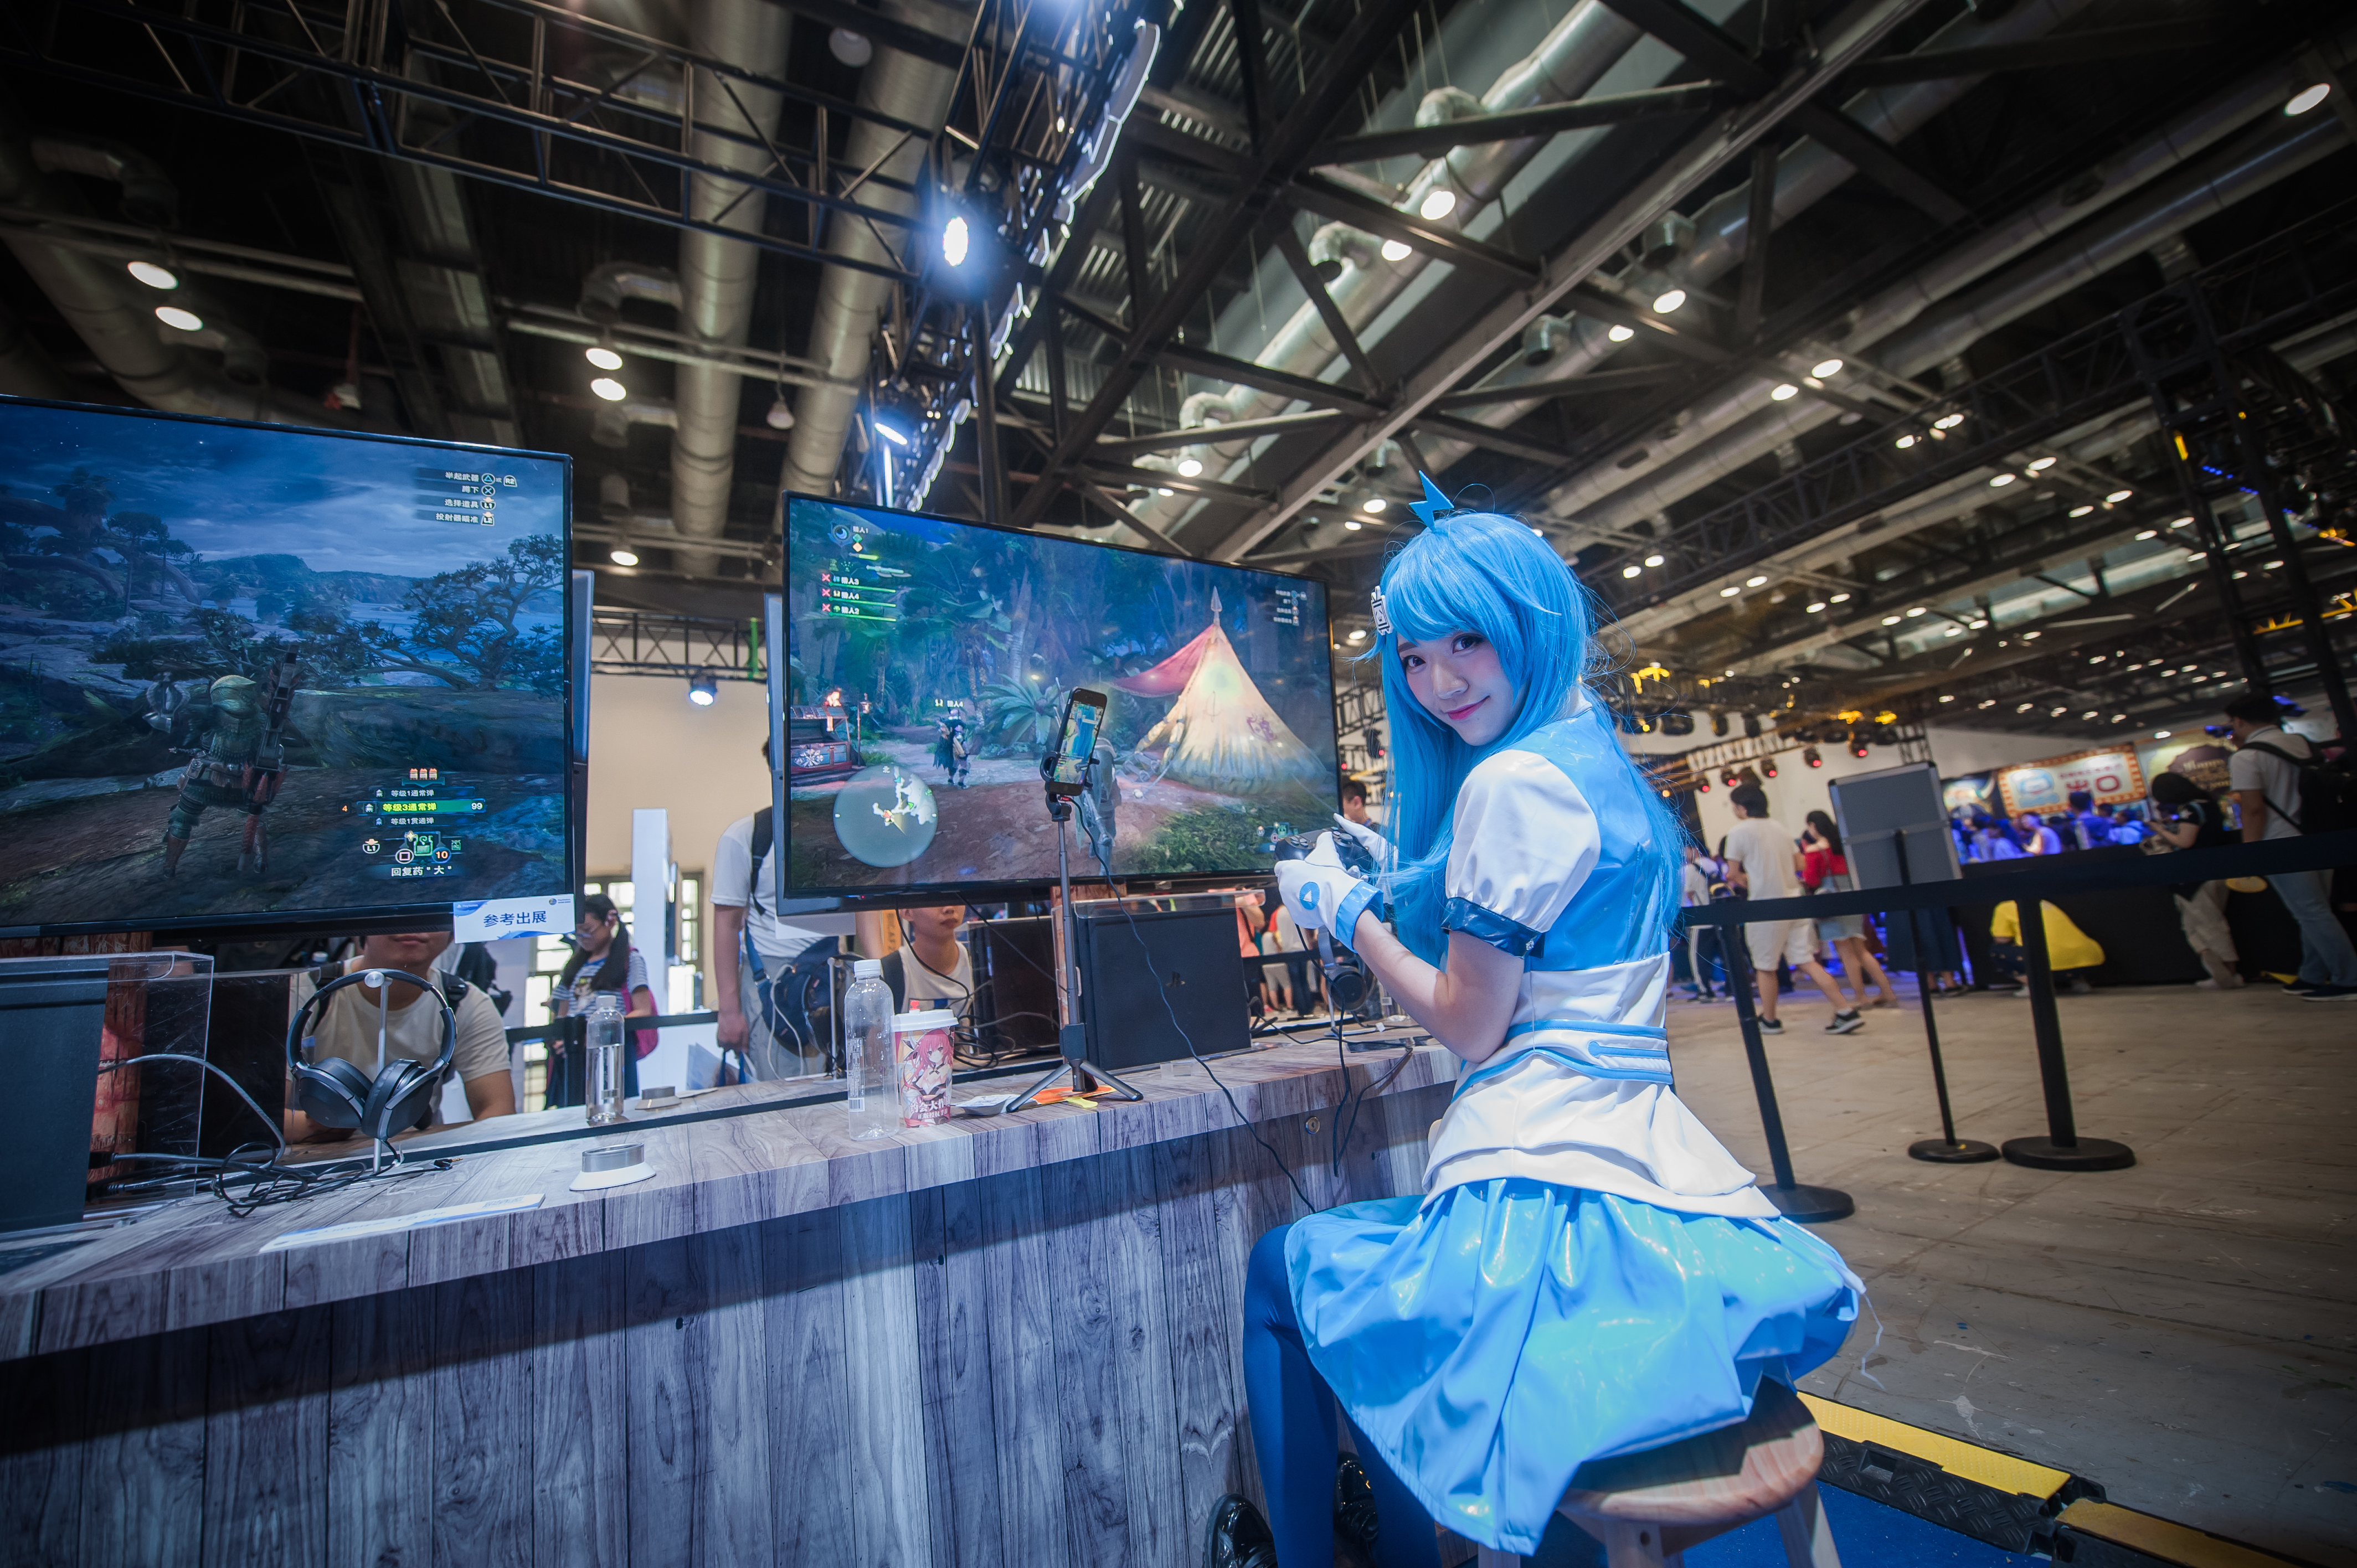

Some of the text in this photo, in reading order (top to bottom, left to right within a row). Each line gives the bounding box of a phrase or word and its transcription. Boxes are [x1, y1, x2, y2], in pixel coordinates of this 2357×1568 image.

[445, 499, 479, 508] 选择道具
[383, 803, 437, 812] 等级3通常弹
[435, 850, 448, 859] 10
[483, 911, 547, 927] 参考出展
